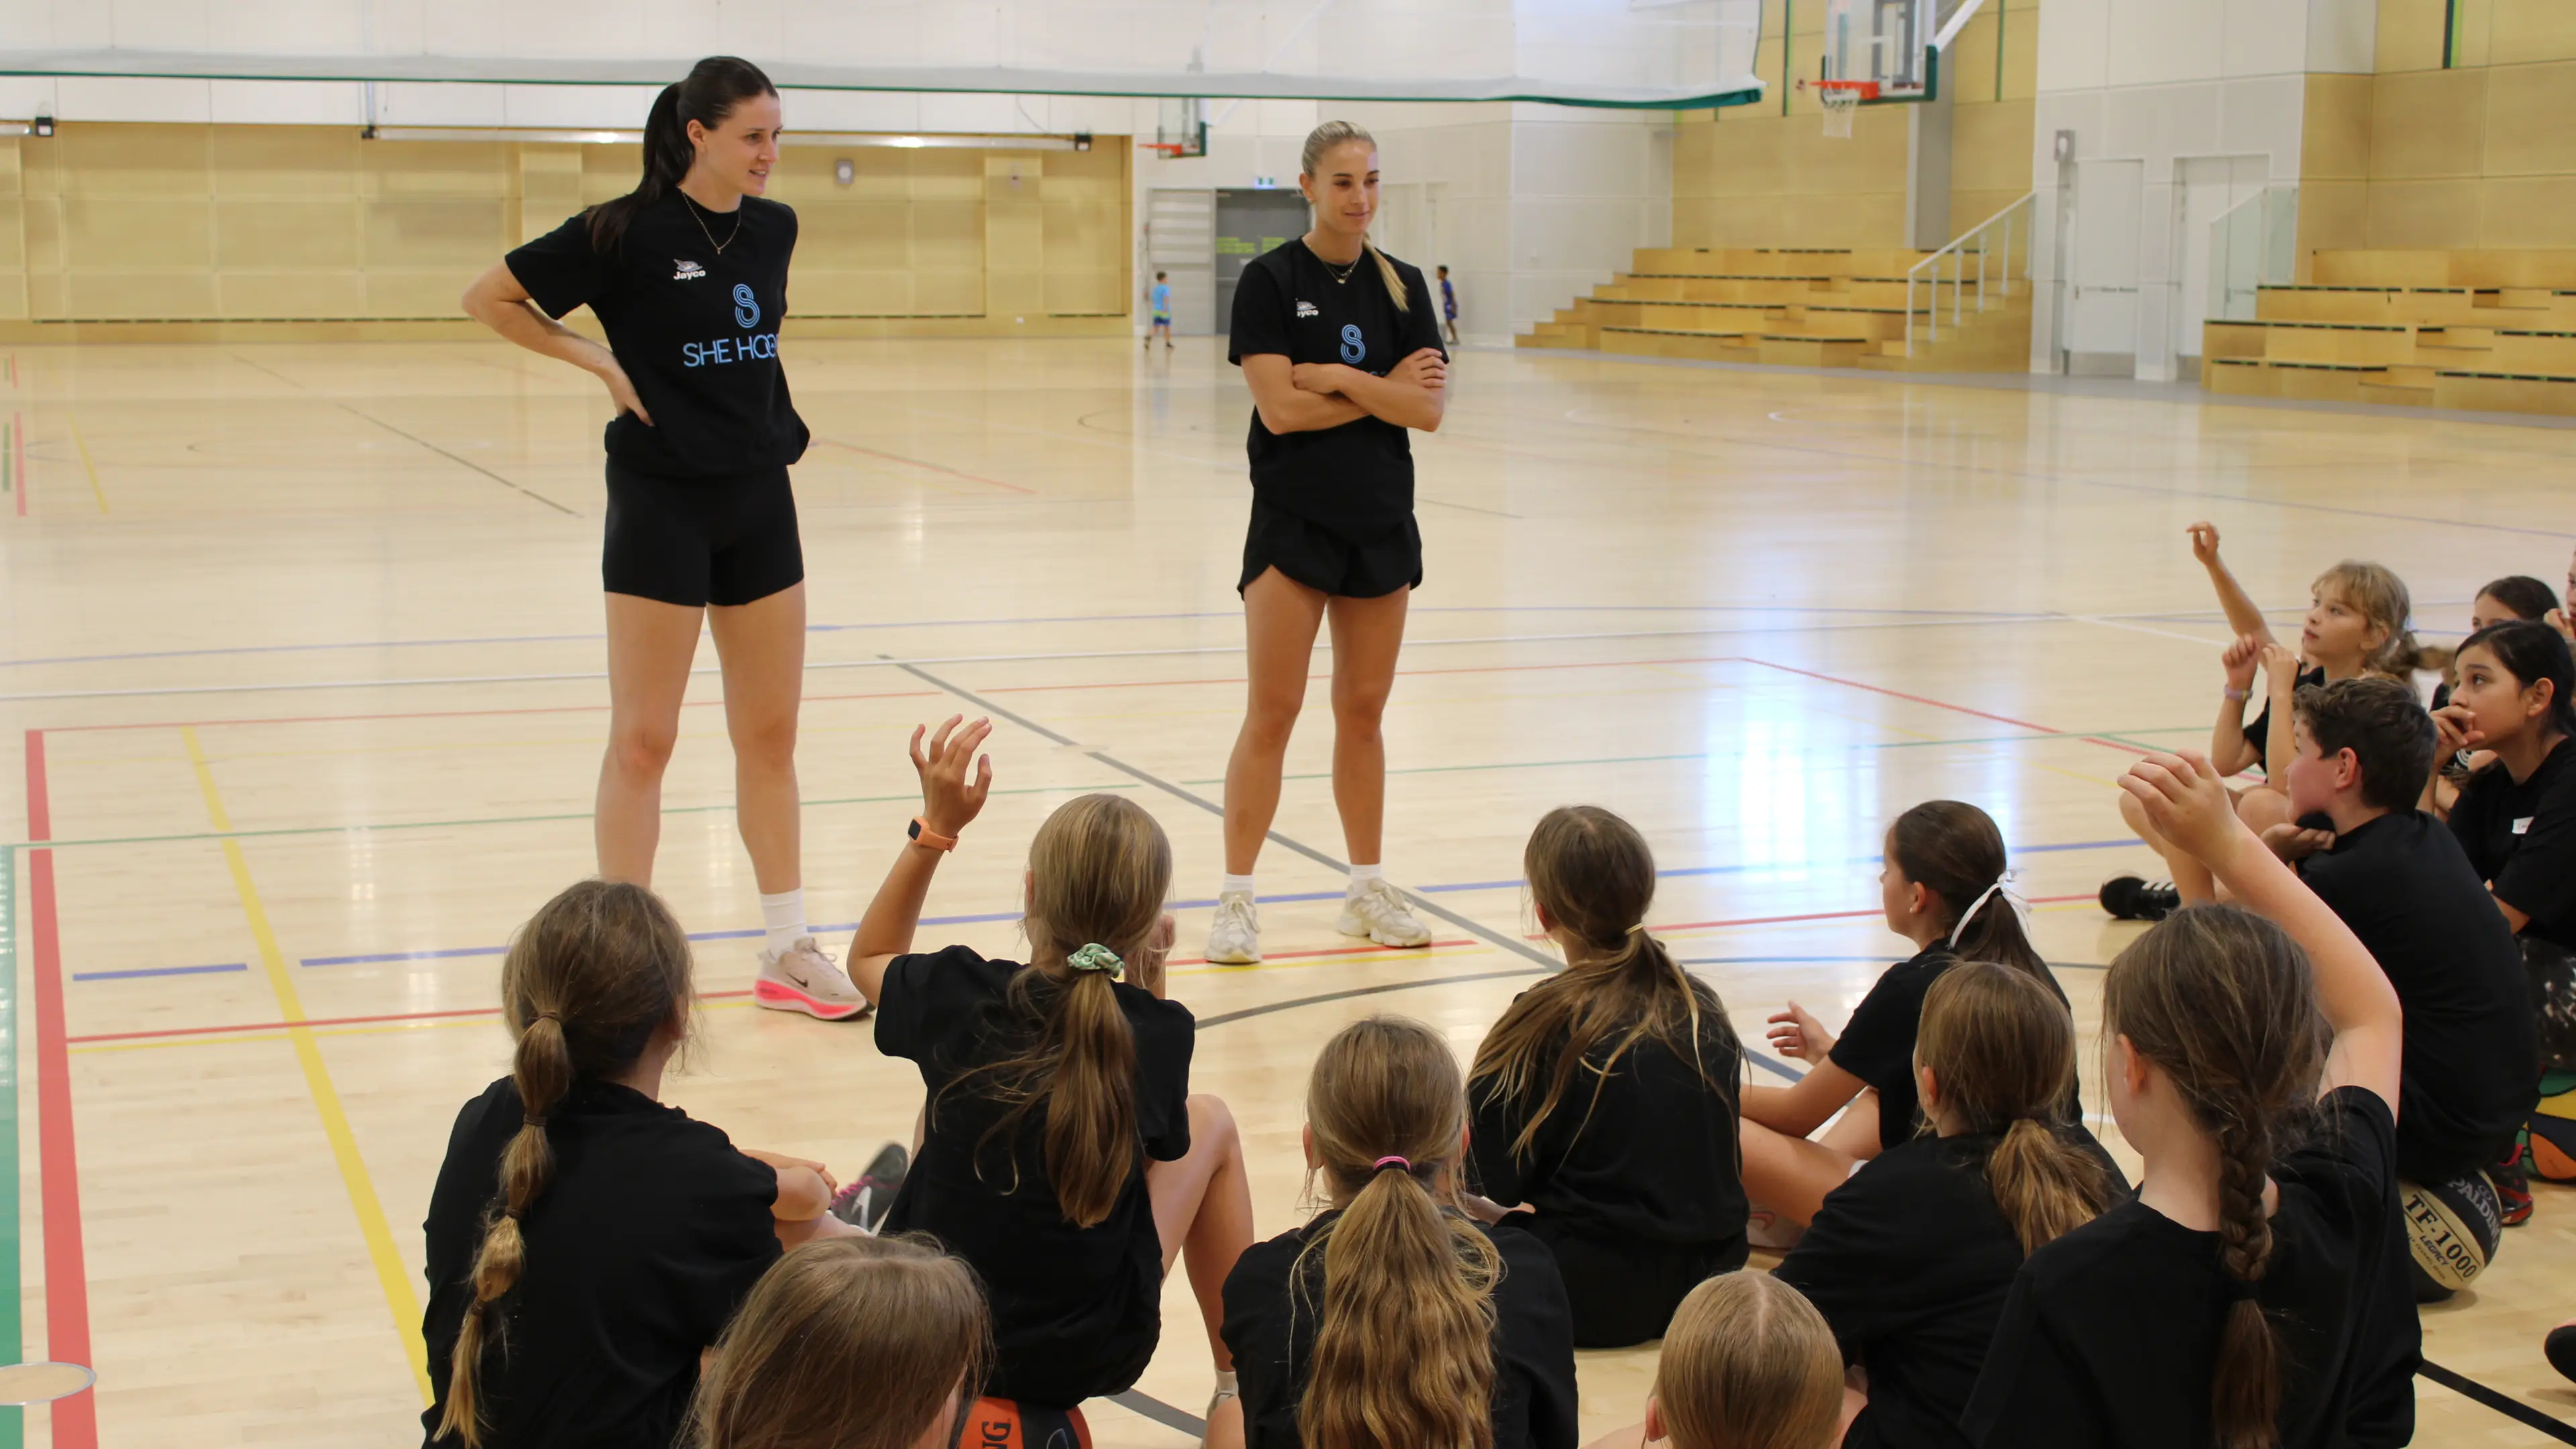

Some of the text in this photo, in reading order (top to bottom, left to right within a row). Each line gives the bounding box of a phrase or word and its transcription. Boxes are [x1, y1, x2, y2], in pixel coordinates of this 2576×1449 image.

[674, 270, 706, 280] Jayco
[1297, 310, 1319, 318] yco
[683, 333, 778, 367] SHE HOO
[2447, 1177, 2502, 1254] PALDIN
[2405, 1194, 2477, 1278] TF-1000
[2419, 1235, 2449, 1265] LEGACY
